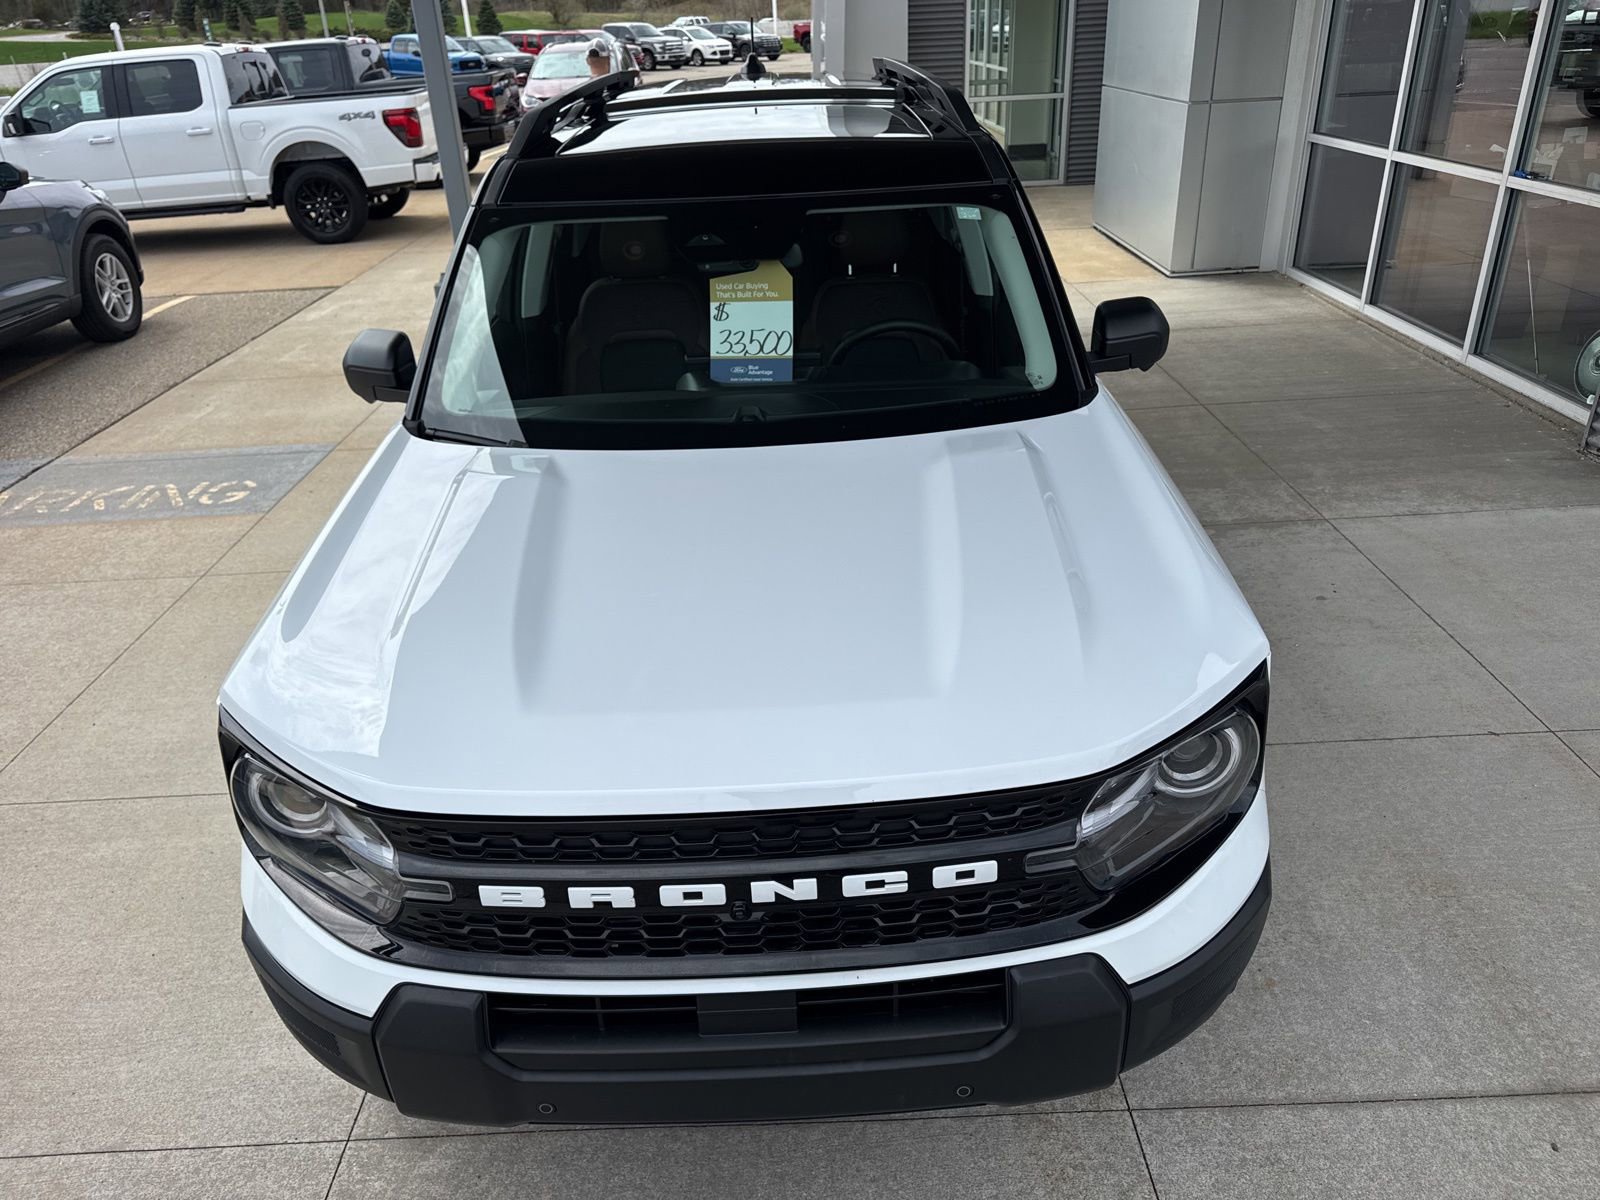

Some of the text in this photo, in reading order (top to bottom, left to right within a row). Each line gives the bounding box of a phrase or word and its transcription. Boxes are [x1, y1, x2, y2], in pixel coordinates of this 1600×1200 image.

[746, 282, 768, 290] Buying
[713, 302, 730, 321] $
[716, 328, 793, 356] 33,500
[0, 480, 258, 515] RKING
[477, 859, 1000, 908] BRONCO
